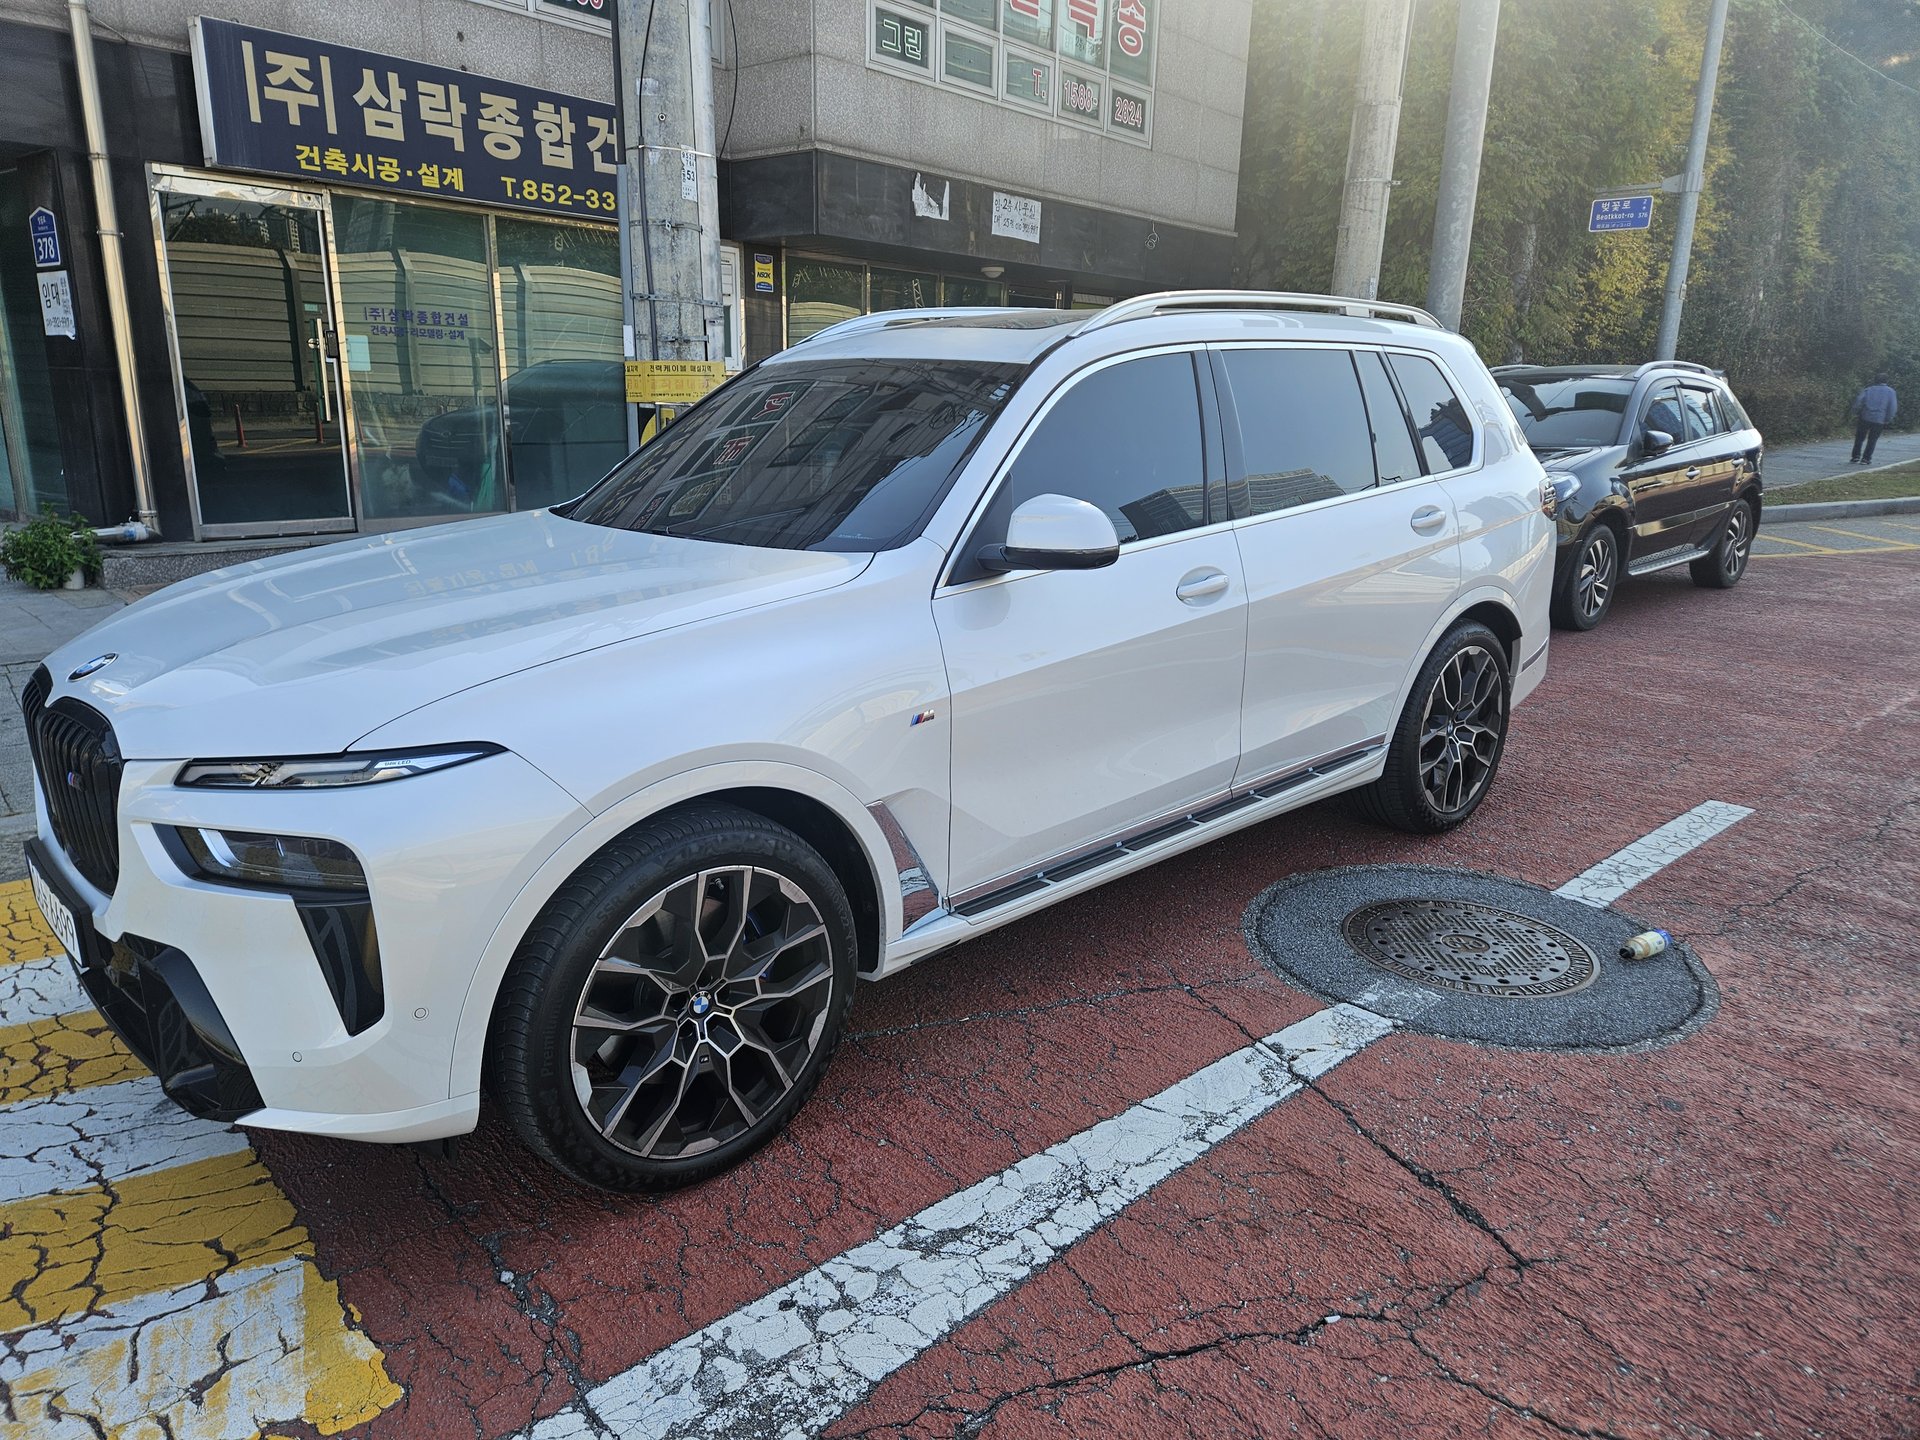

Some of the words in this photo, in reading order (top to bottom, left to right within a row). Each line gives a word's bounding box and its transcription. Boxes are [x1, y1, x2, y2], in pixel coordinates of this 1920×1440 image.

[882, 19, 922, 60] 그린
[1114, 96, 1143, 128] 2824
[1596, 212, 1635, 221] Beotkkot-ro
[1601, 200, 1631, 212] 벚꽃로
[37, 236, 55, 262] 378
[757, 271, 771, 279] NSOK
[42, 282, 61, 309] 임대
